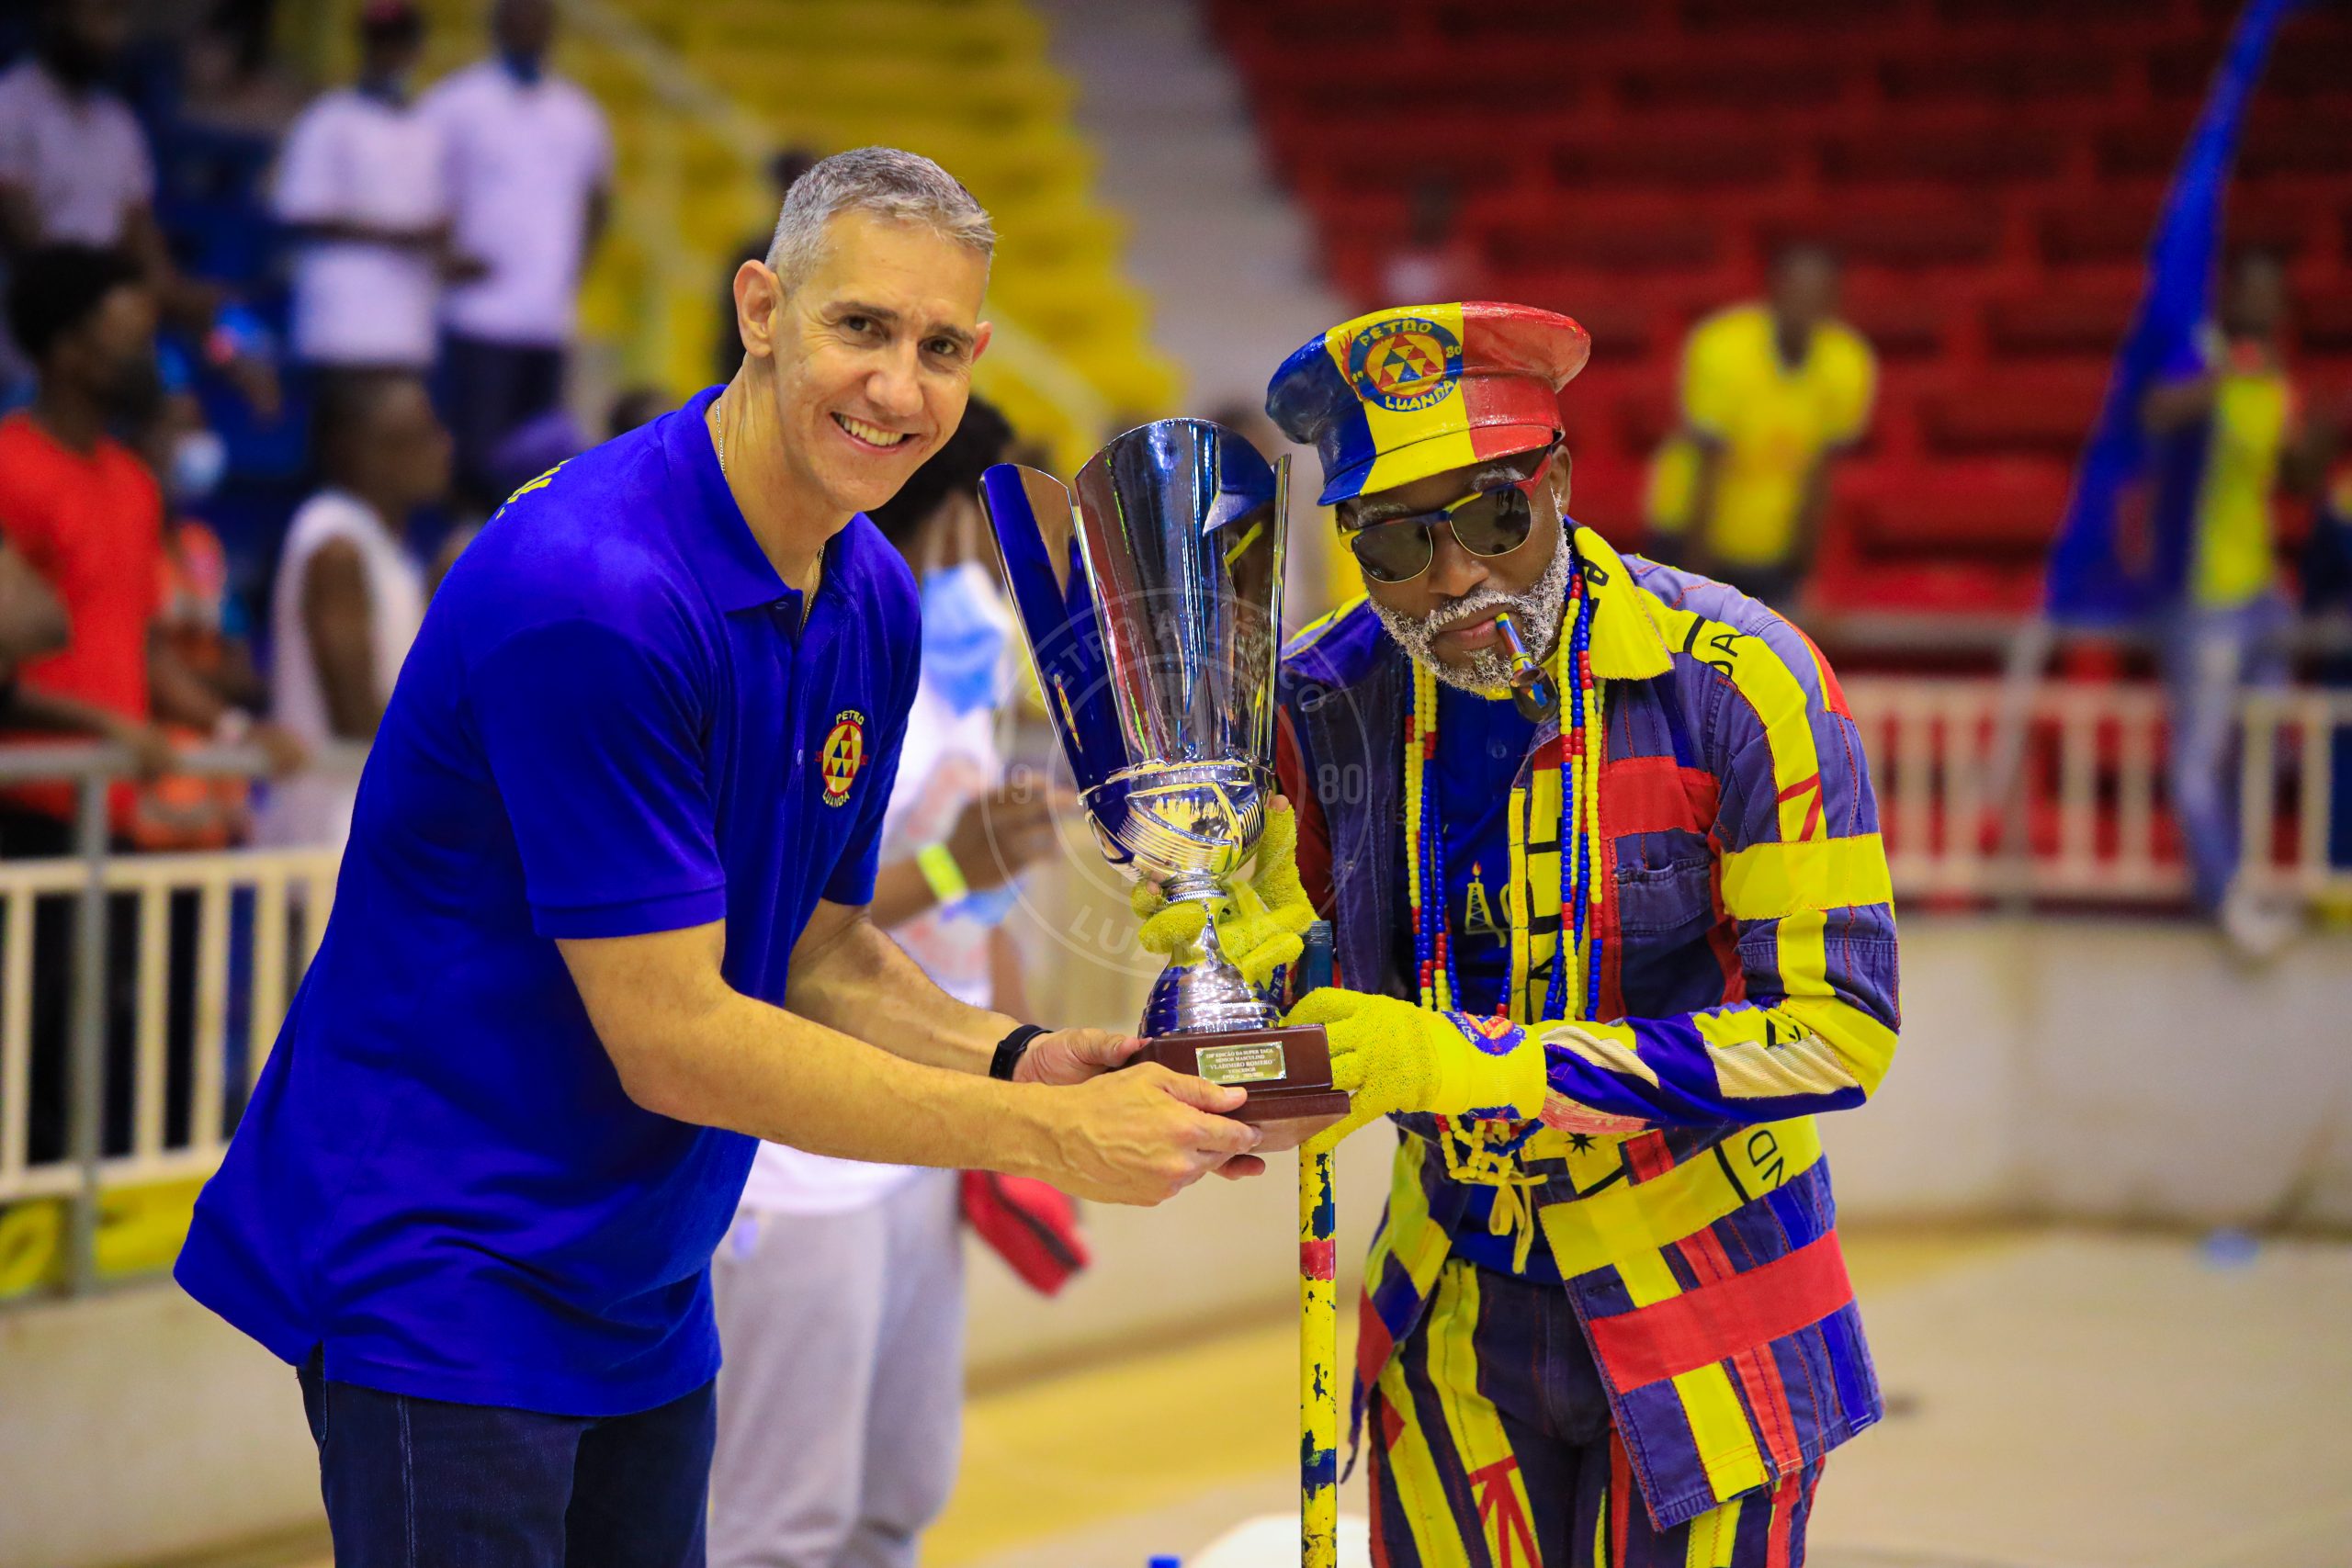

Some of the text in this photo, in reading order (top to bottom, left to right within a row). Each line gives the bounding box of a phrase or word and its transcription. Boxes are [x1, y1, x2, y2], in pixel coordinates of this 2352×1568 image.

[1445, 344, 1463, 358] 80
[1385, 379, 1454, 411] LUANDA
[836, 709, 865, 726] PETRO
[822, 787, 850, 807] LUANDA
